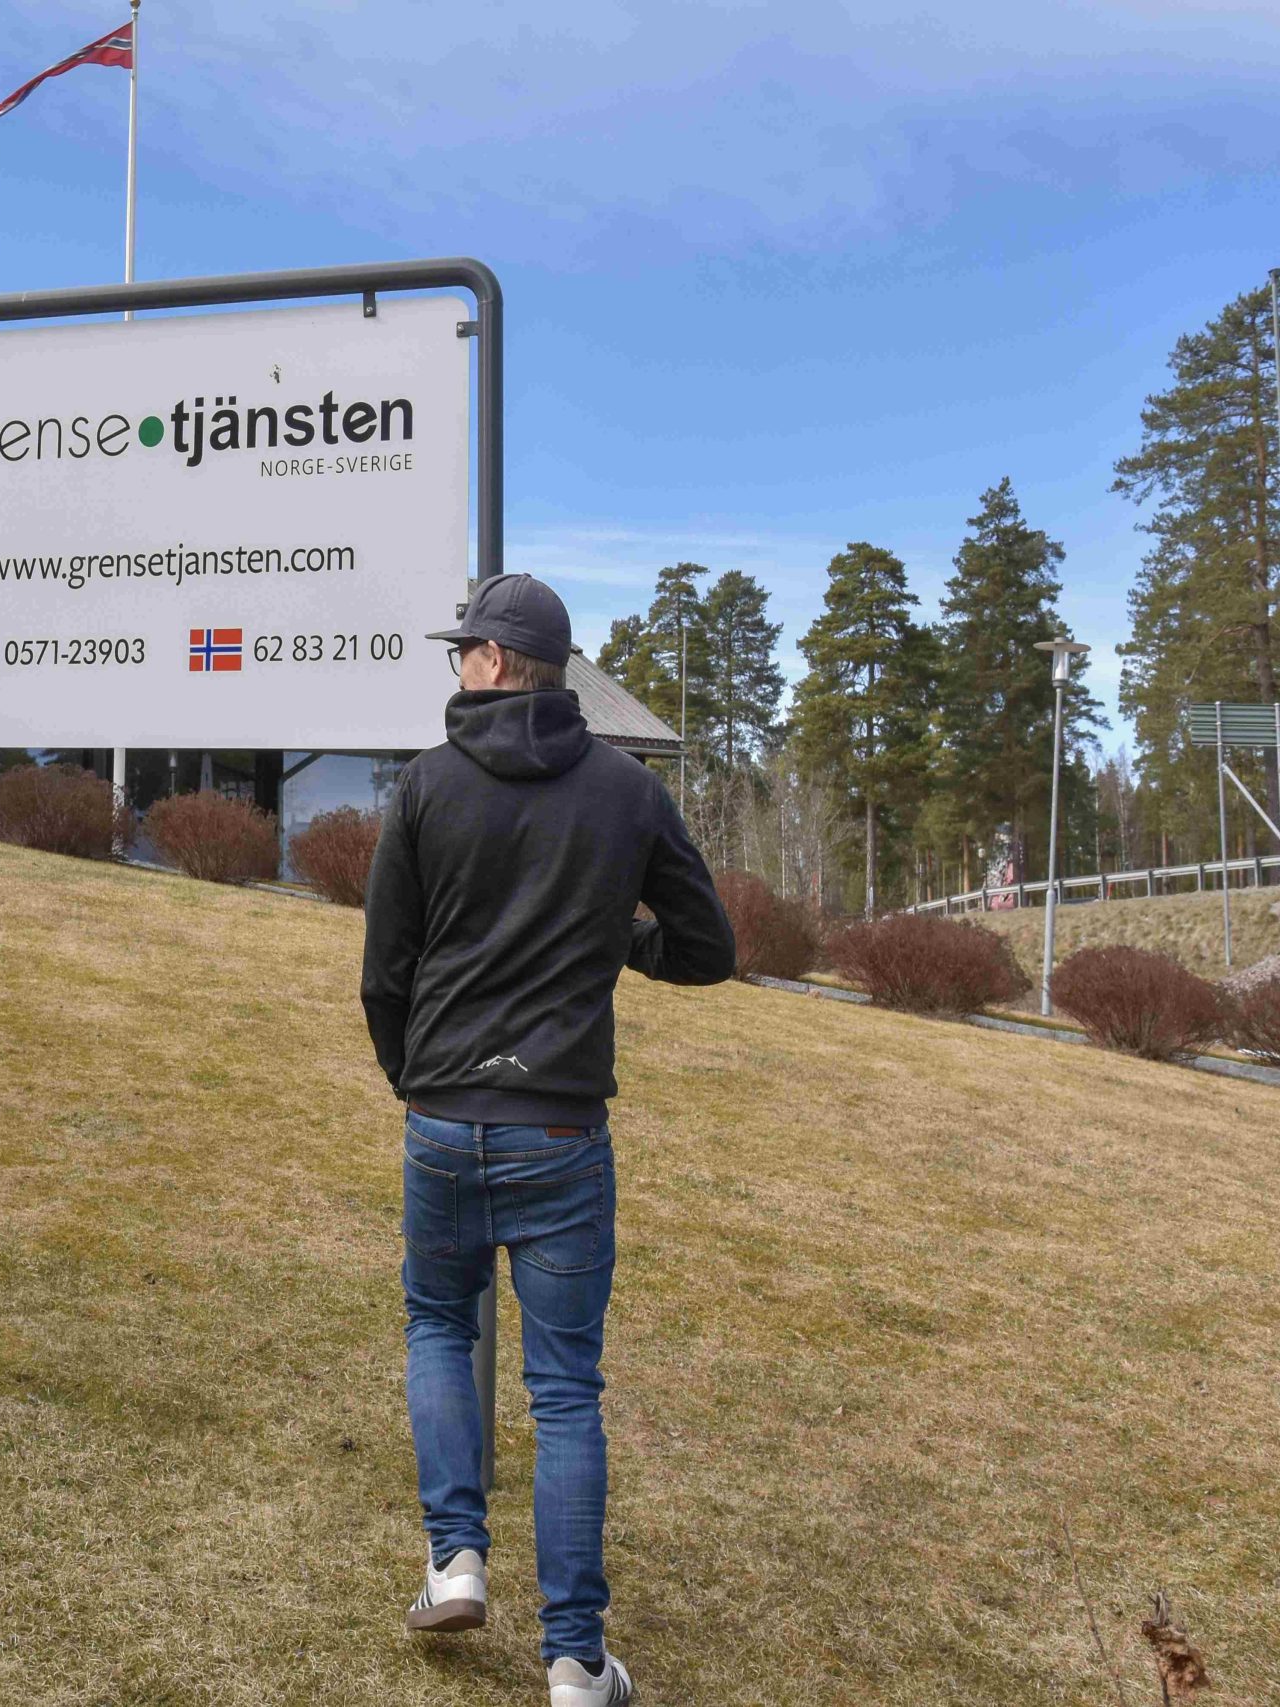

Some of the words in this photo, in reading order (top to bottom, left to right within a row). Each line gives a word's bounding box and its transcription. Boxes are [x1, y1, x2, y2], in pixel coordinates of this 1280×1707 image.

[171, 390, 413, 468] tjänsten
[260, 453, 413, 478] NORGE-SVERIGE
[4, 638, 146, 667] 0571-23903
[253, 635, 283, 663] 62
[292, 634, 324, 662] 83
[332, 634, 358, 661] 21
[370, 633, 404, 661] 00
